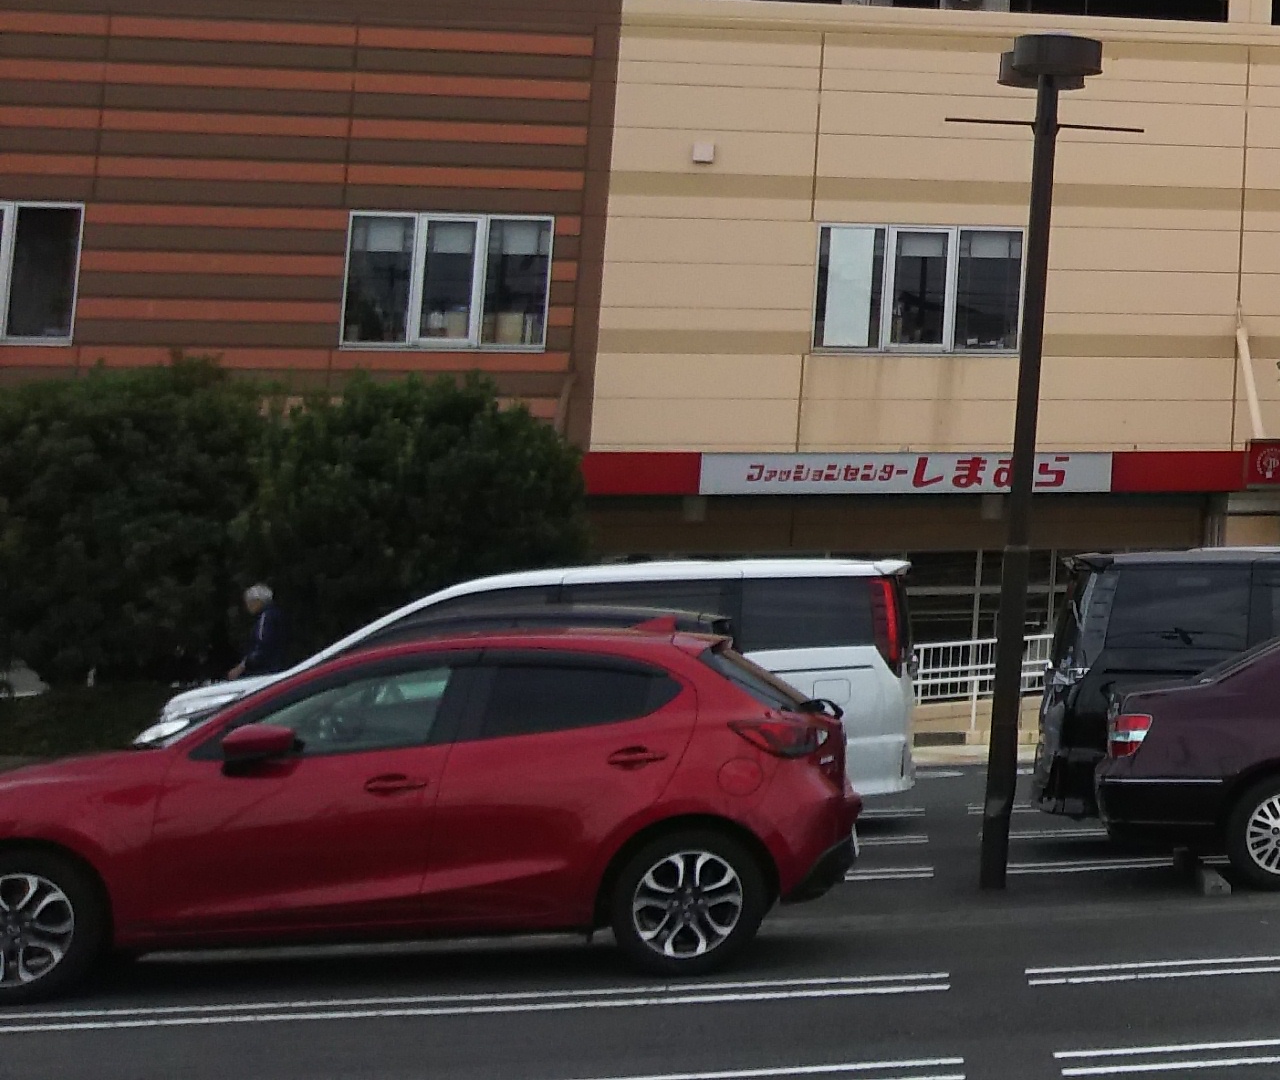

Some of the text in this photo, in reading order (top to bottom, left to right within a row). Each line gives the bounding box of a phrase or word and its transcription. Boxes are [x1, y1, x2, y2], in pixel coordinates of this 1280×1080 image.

[747, 464, 908, 482] ファッションセンター
